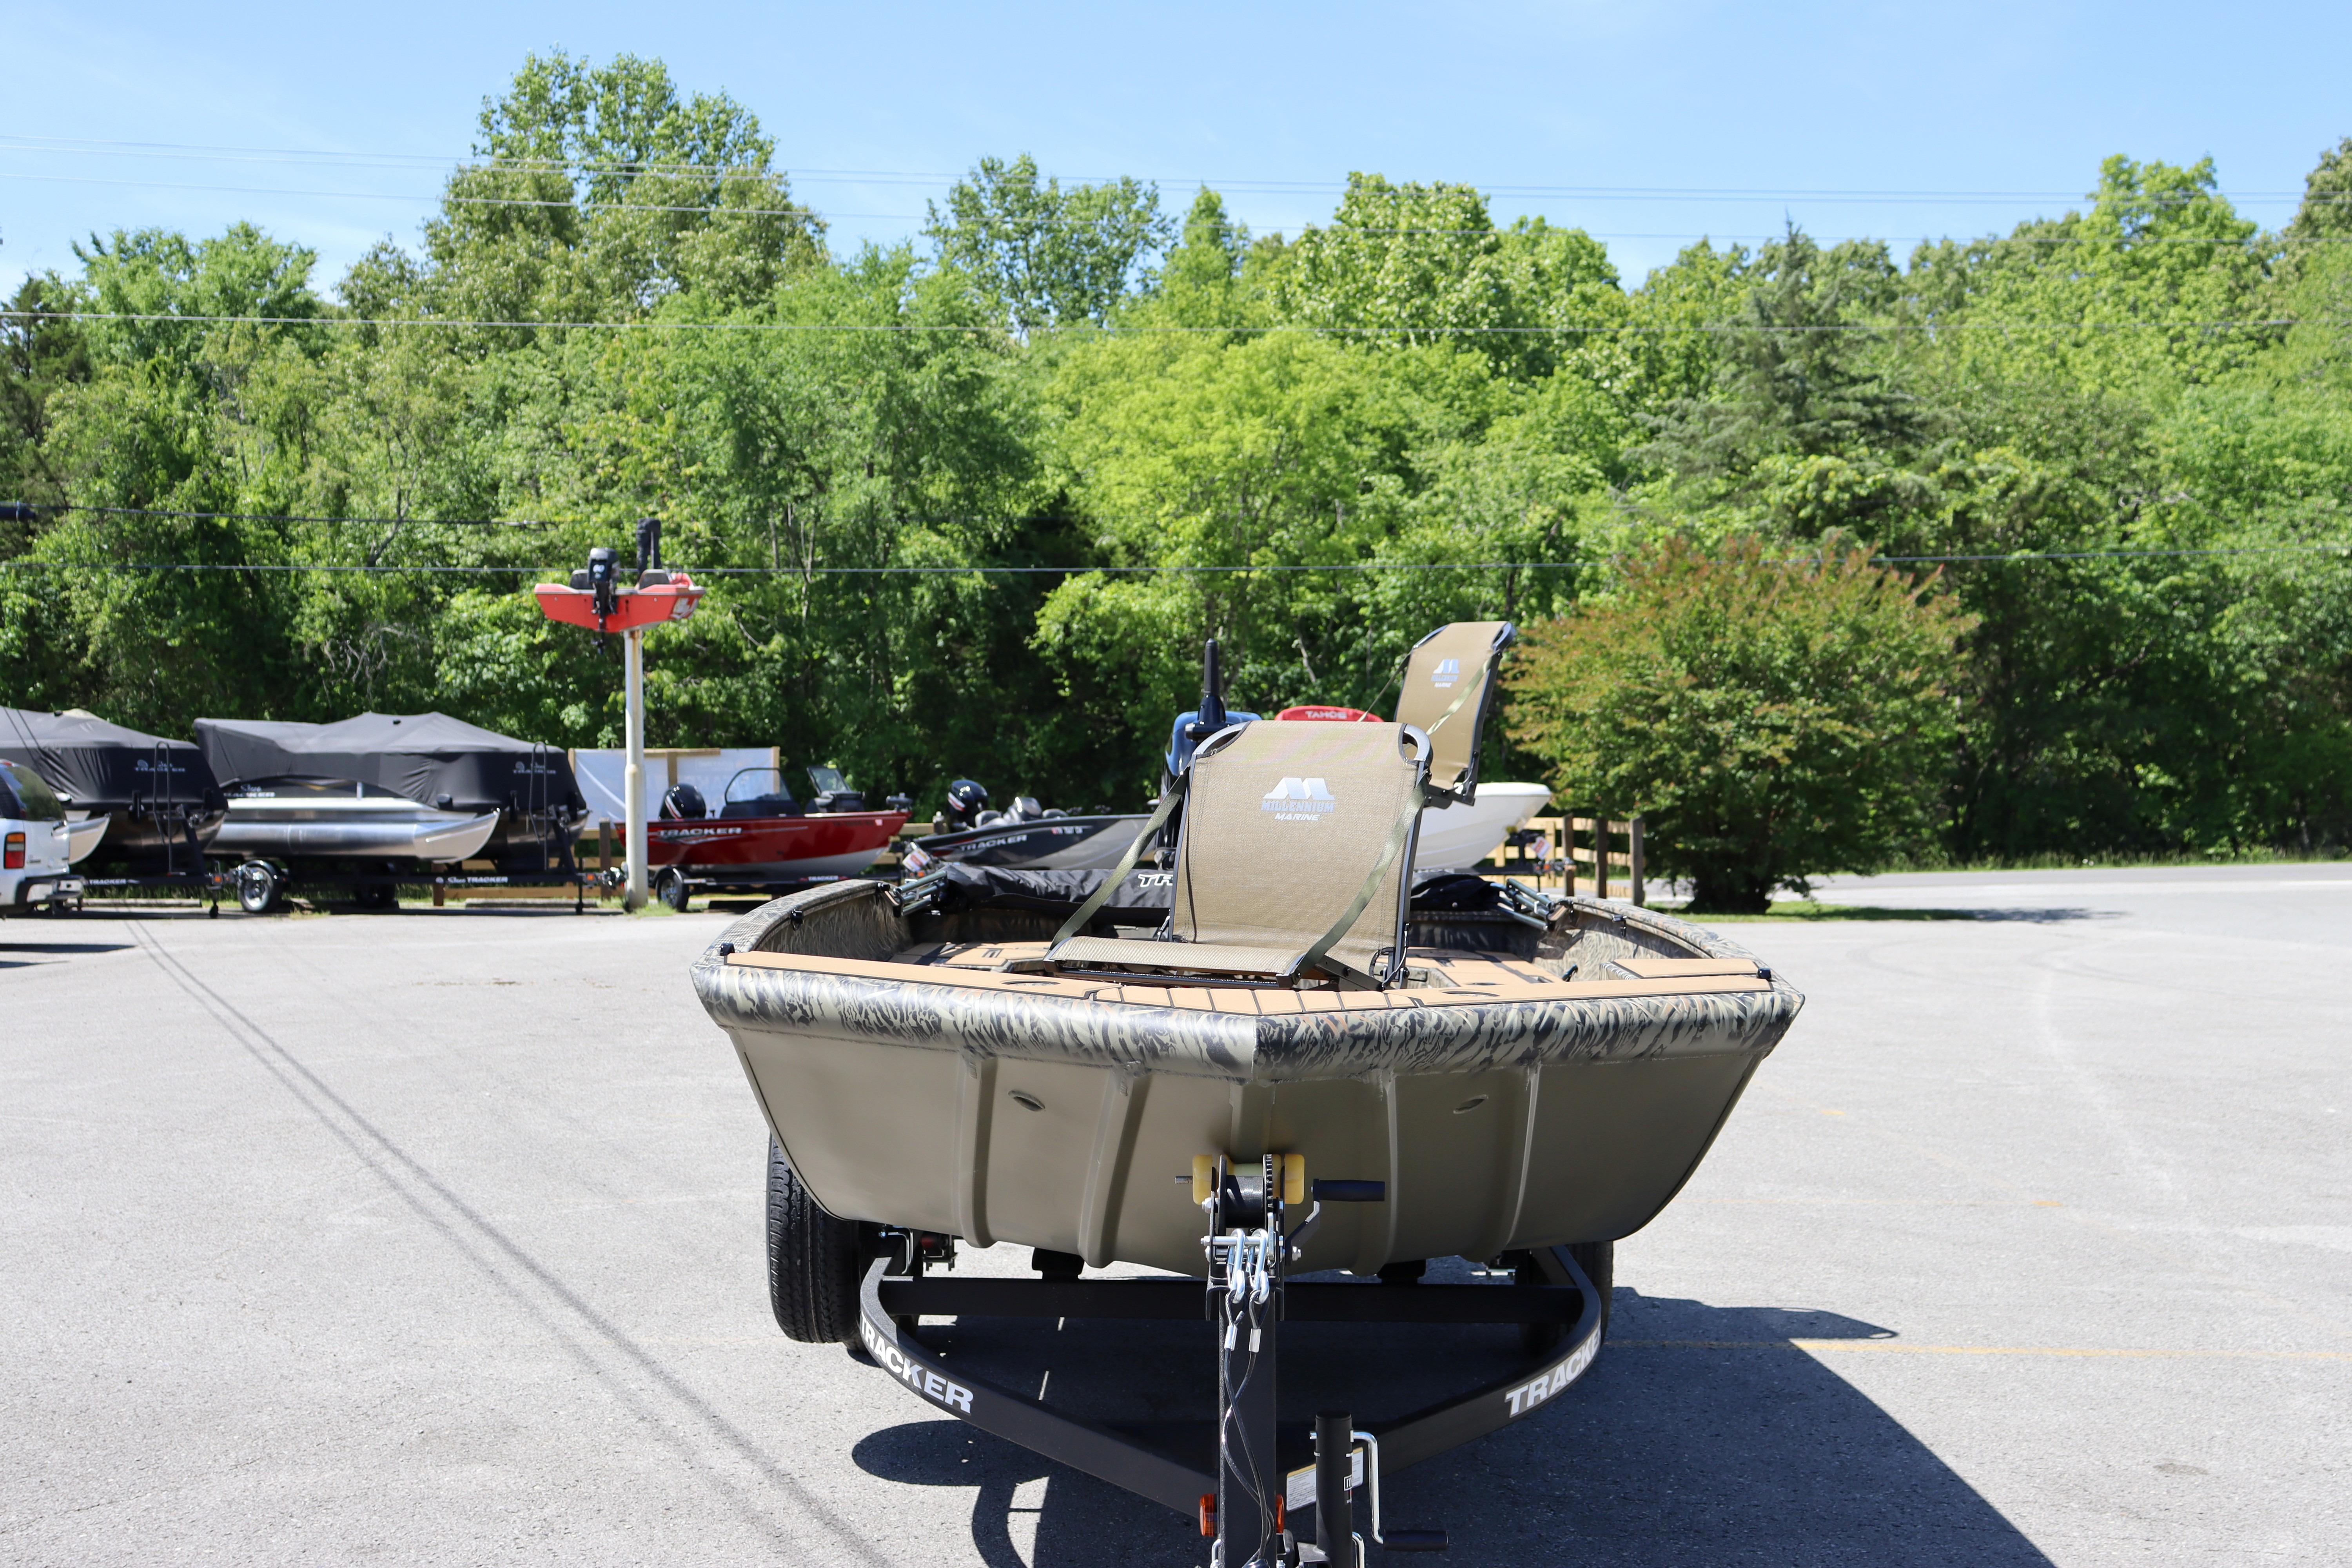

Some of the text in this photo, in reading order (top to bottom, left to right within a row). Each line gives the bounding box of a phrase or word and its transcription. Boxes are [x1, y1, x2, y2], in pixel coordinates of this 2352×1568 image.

[1304, 710, 1348, 720] TAHOE
[1260, 800, 1335, 813] MILLENNIUM
[1274, 813, 1321, 821] MARINE
[658, 827, 742, 838] TRACKER
[960, 834, 1028, 851] TRACKER
[860, 1310, 974, 1414] TRACKER
